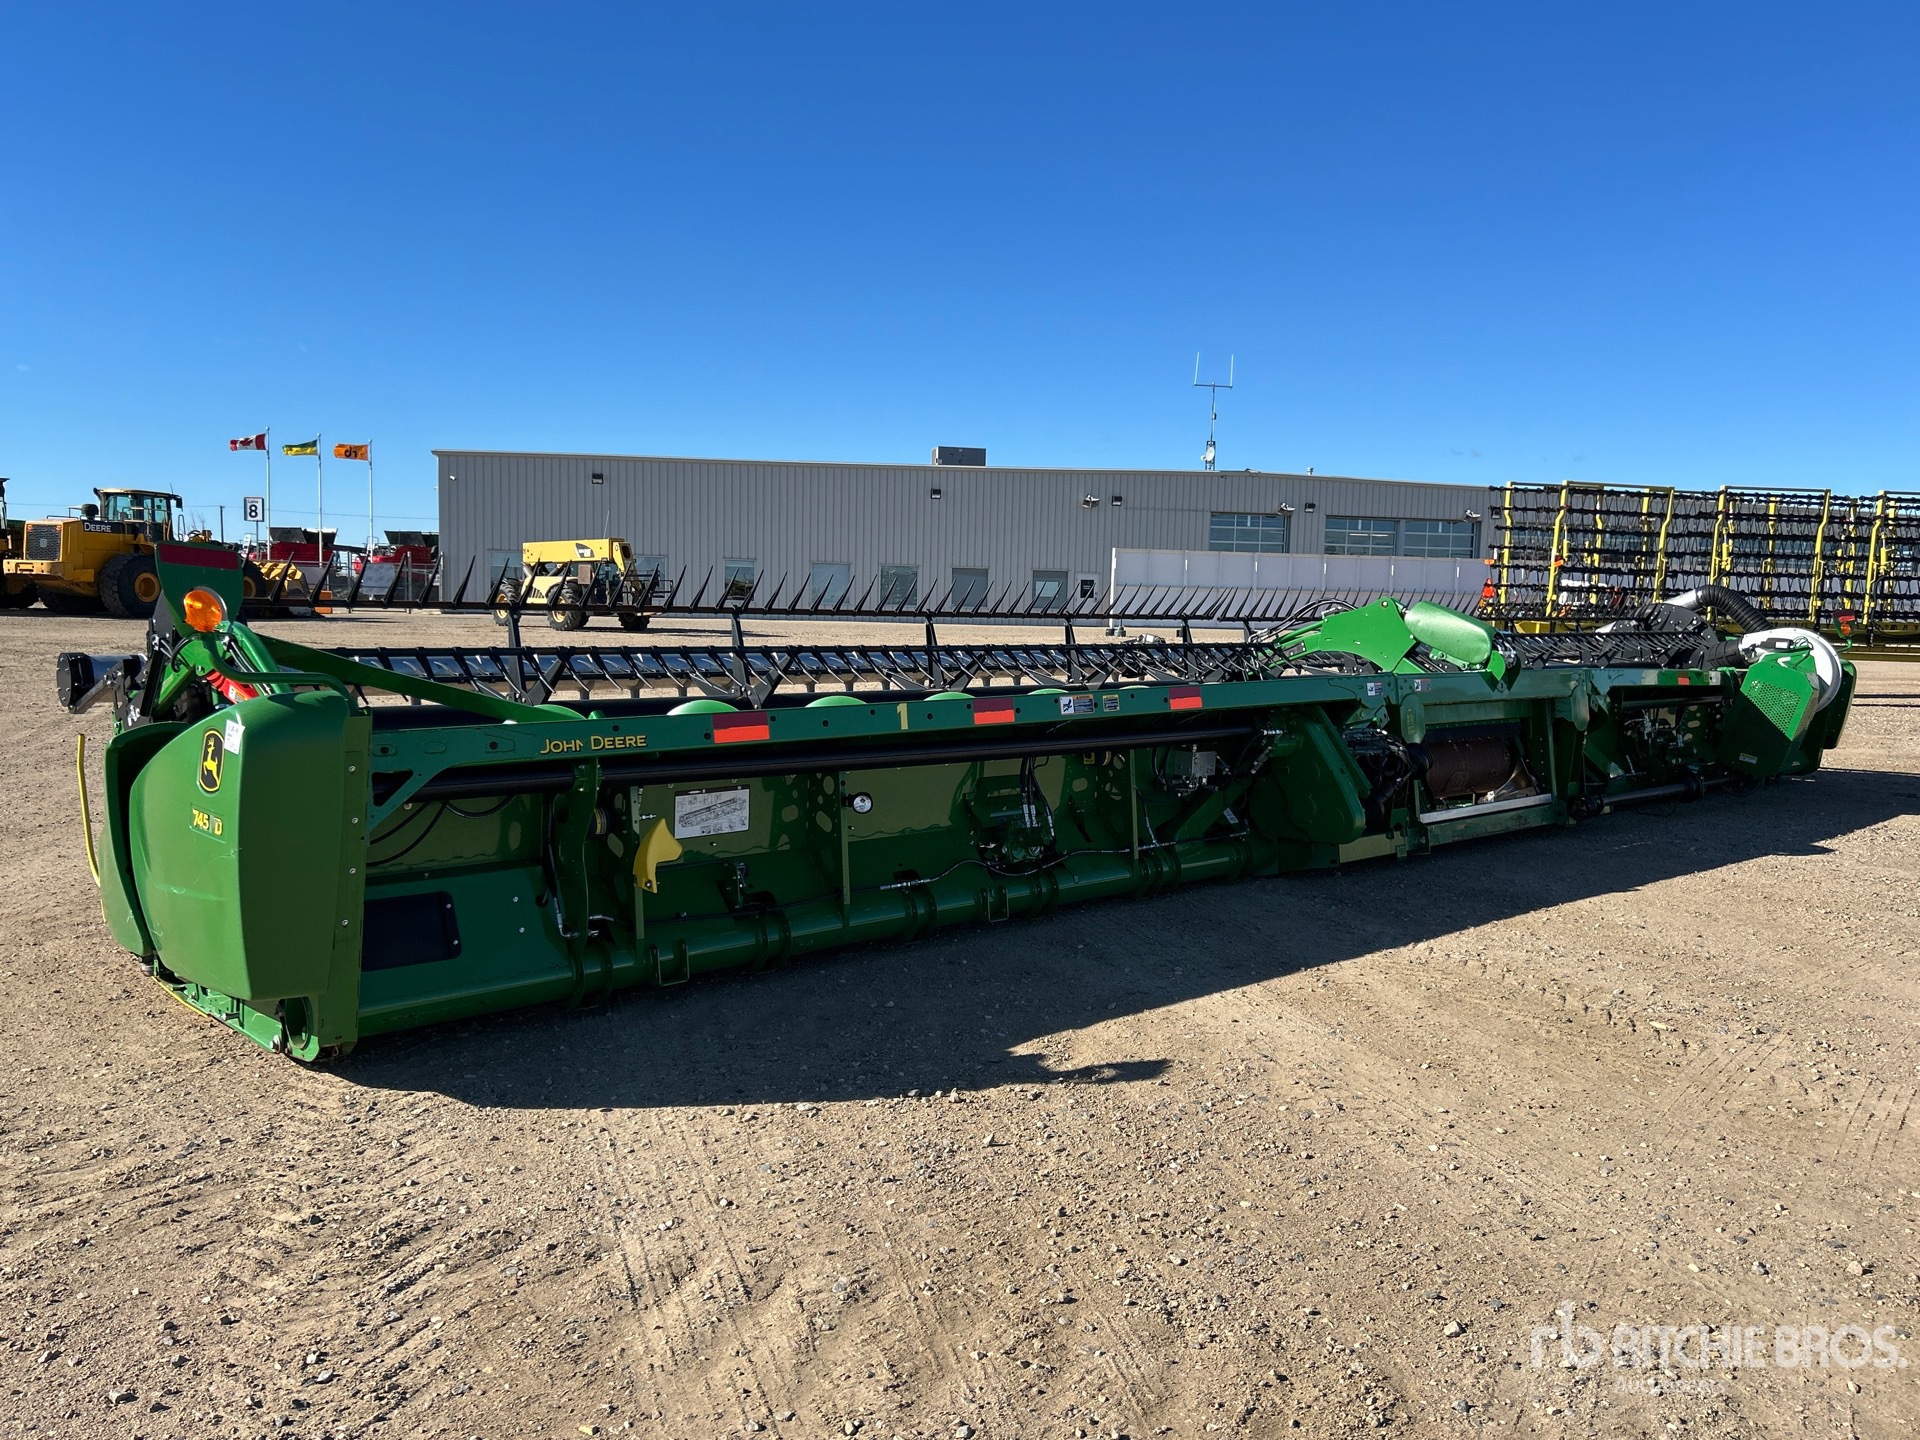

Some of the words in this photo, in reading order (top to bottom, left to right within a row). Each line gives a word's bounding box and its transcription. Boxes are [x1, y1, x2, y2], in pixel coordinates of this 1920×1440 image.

[248, 504, 258, 518] 8
[84, 522, 112, 532] DEERE
[896, 702, 909, 730] 1
[590, 735, 647, 750] DEERE
[192, 808, 210, 831] 745
